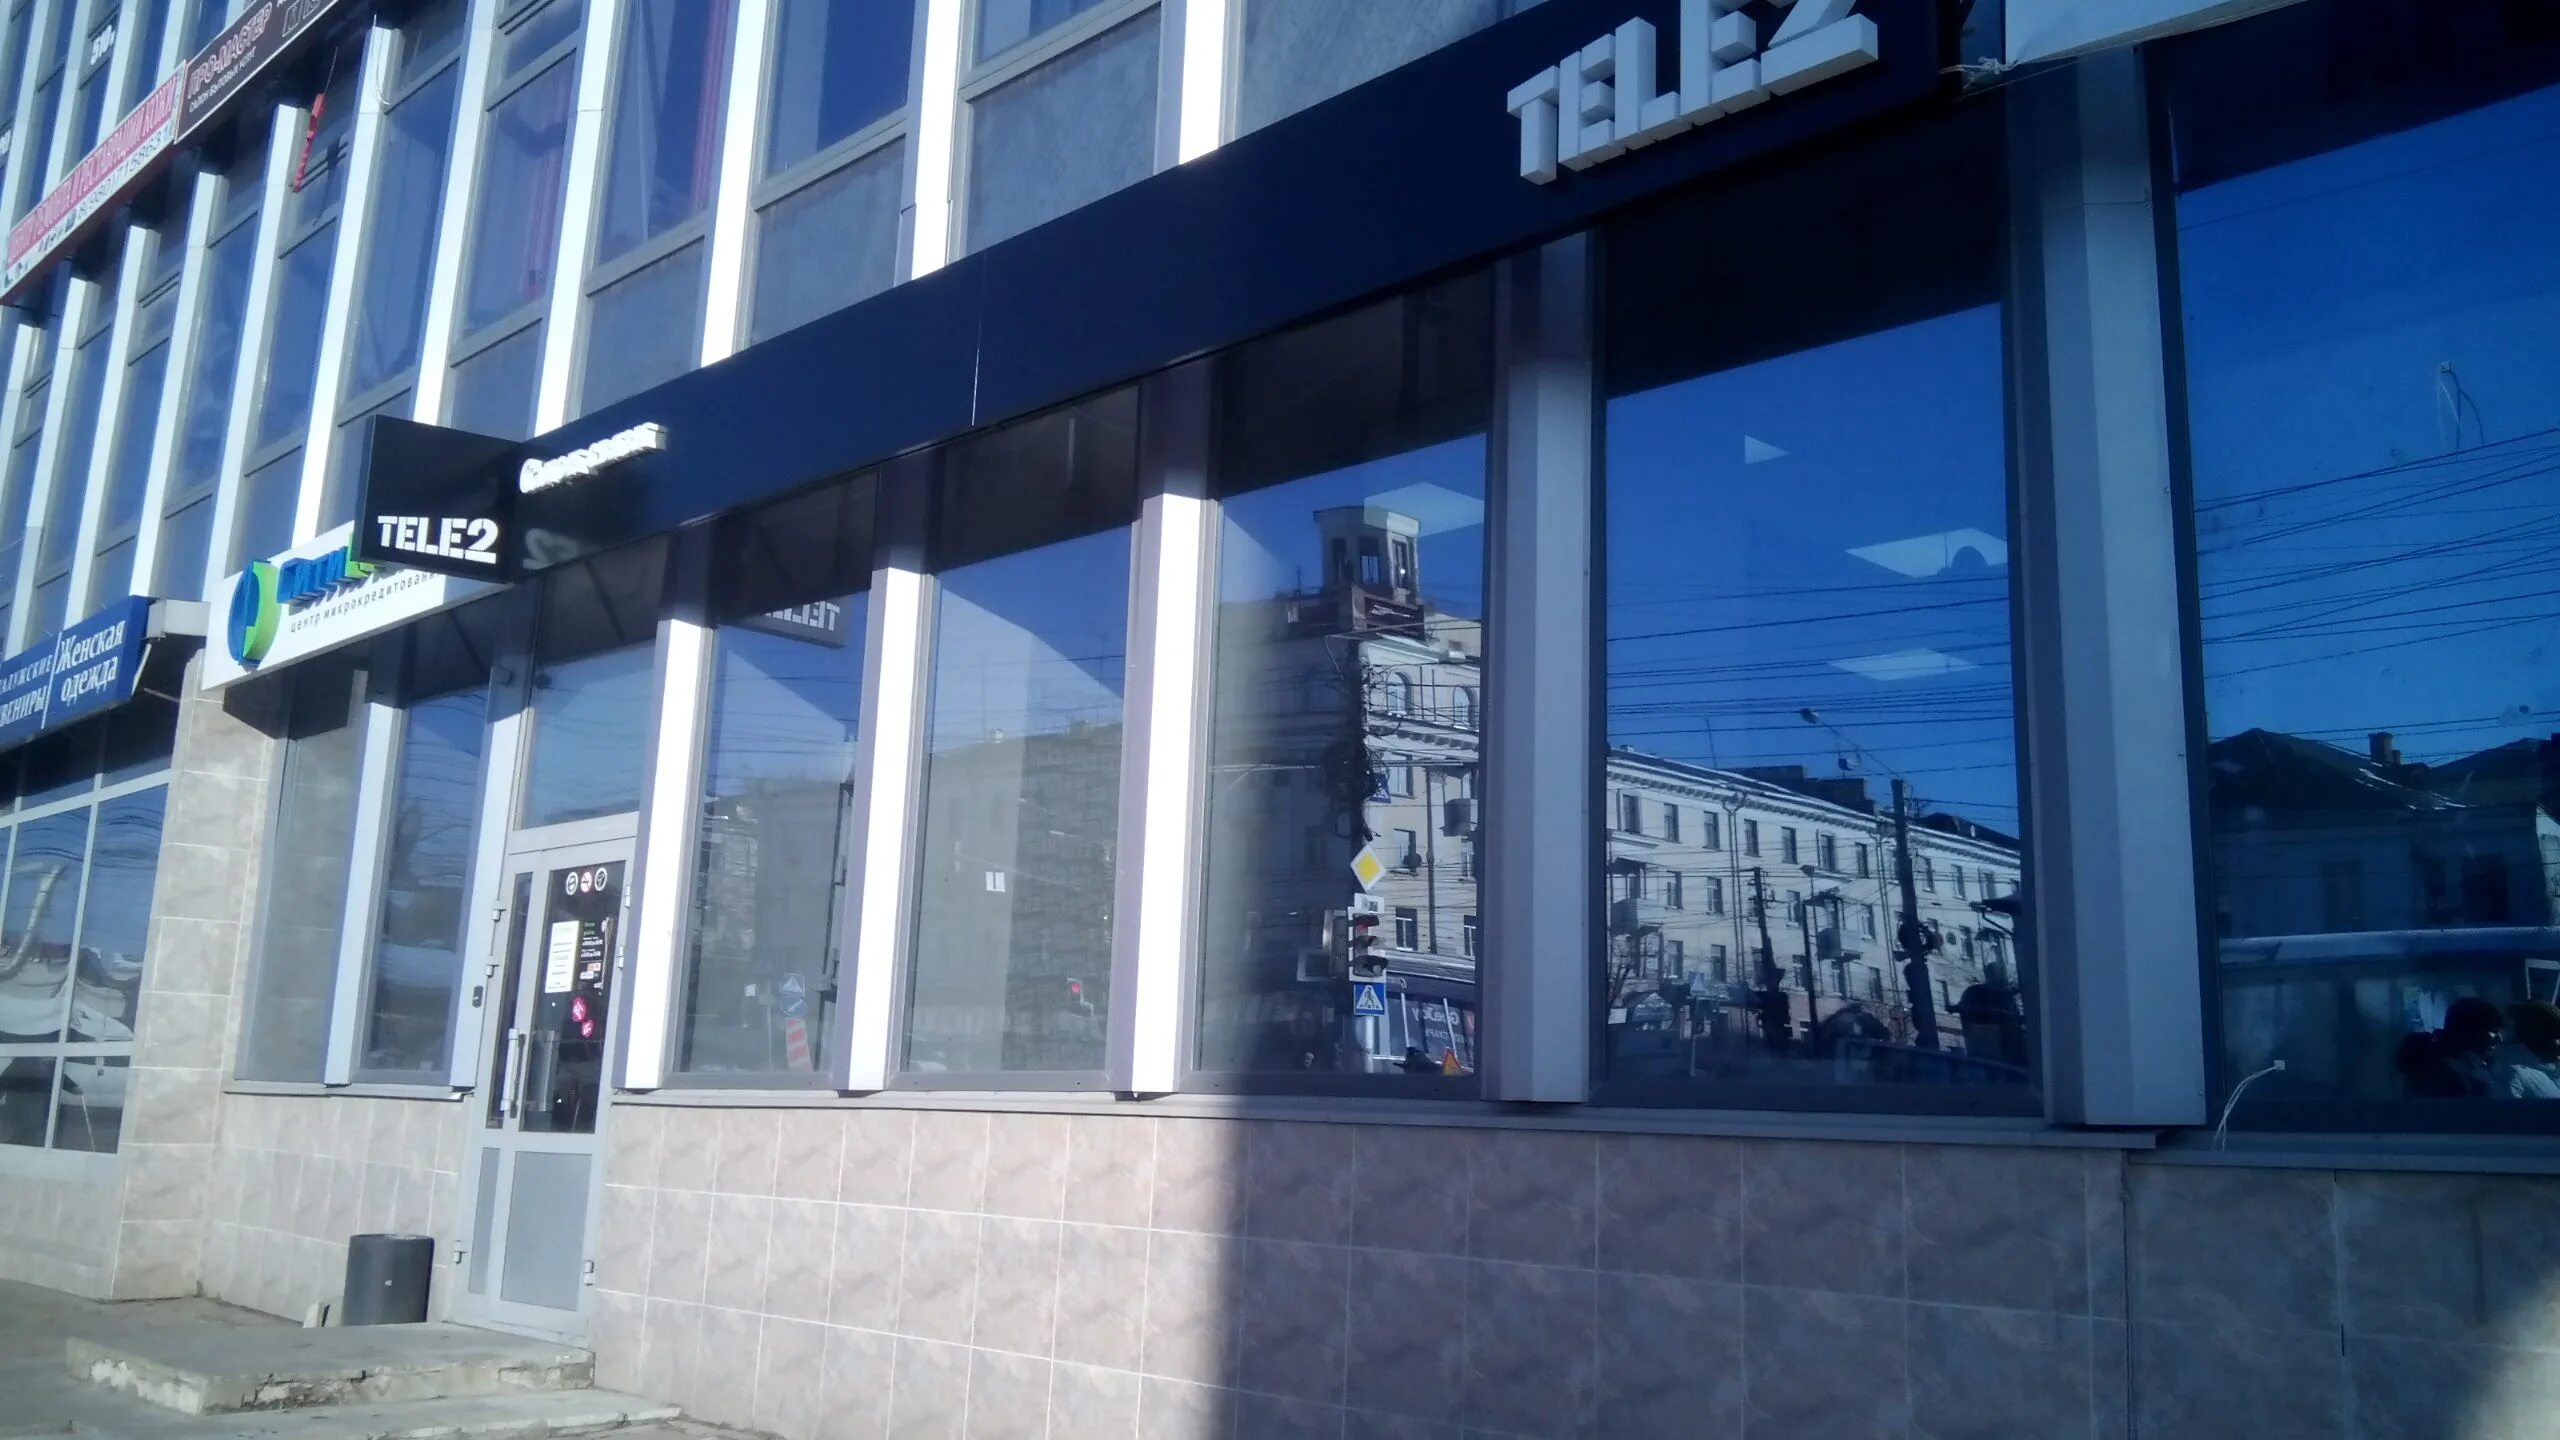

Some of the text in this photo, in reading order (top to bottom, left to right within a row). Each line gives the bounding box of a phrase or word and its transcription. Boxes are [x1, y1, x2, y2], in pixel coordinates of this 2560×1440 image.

[1507, 0, 1878, 185] TELE2
[377, 515, 498, 565] TELE2
[55, 620, 126, 674] Женская
[290, 611, 321, 633] центр
[61, 656, 118, 707] одежда
